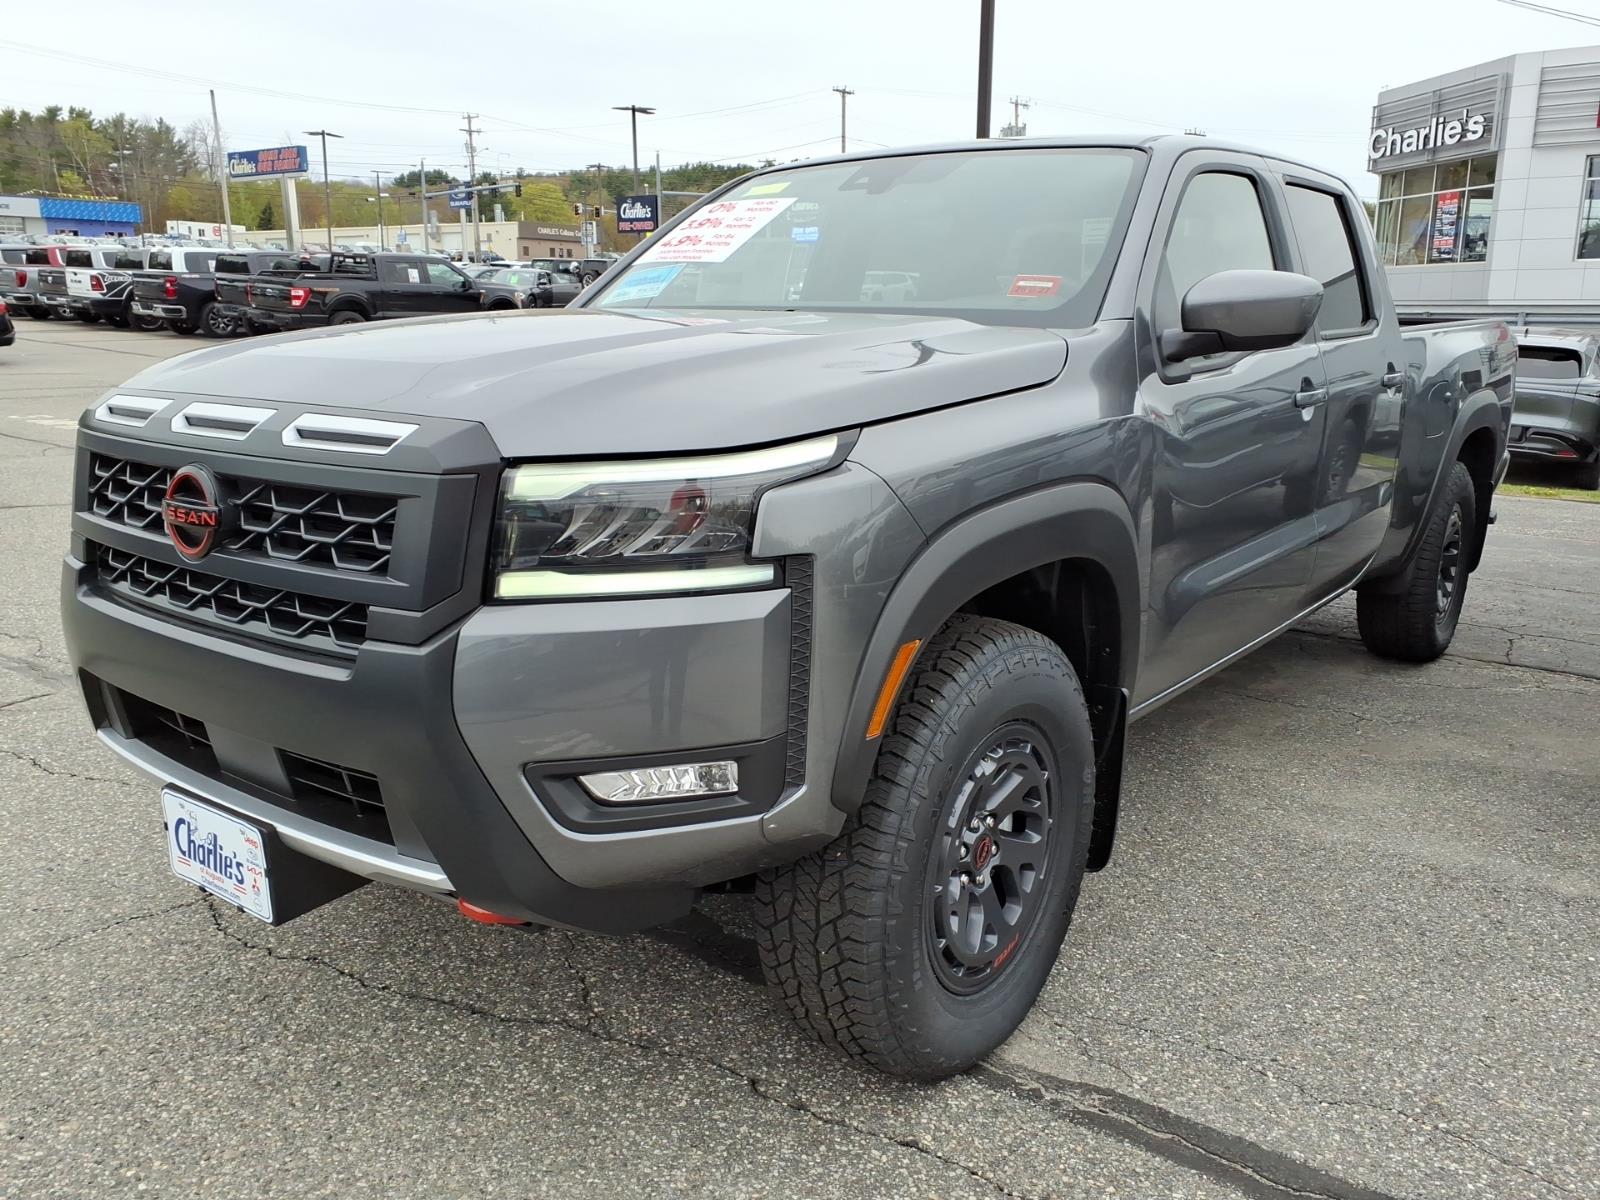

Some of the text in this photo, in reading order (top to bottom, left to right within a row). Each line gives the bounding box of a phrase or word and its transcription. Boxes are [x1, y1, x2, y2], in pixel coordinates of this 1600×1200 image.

[1369, 109, 1485, 159] Charlie's
[229, 158, 256, 174] Charlie's
[620, 202, 651, 218] Charlie's
[619, 222, 654, 230] PRE-OWNED
[680, 217, 724, 230] 3.9%
[660, 235, 704, 247] 4.9%
[175, 818, 244, 885] Charlie's
